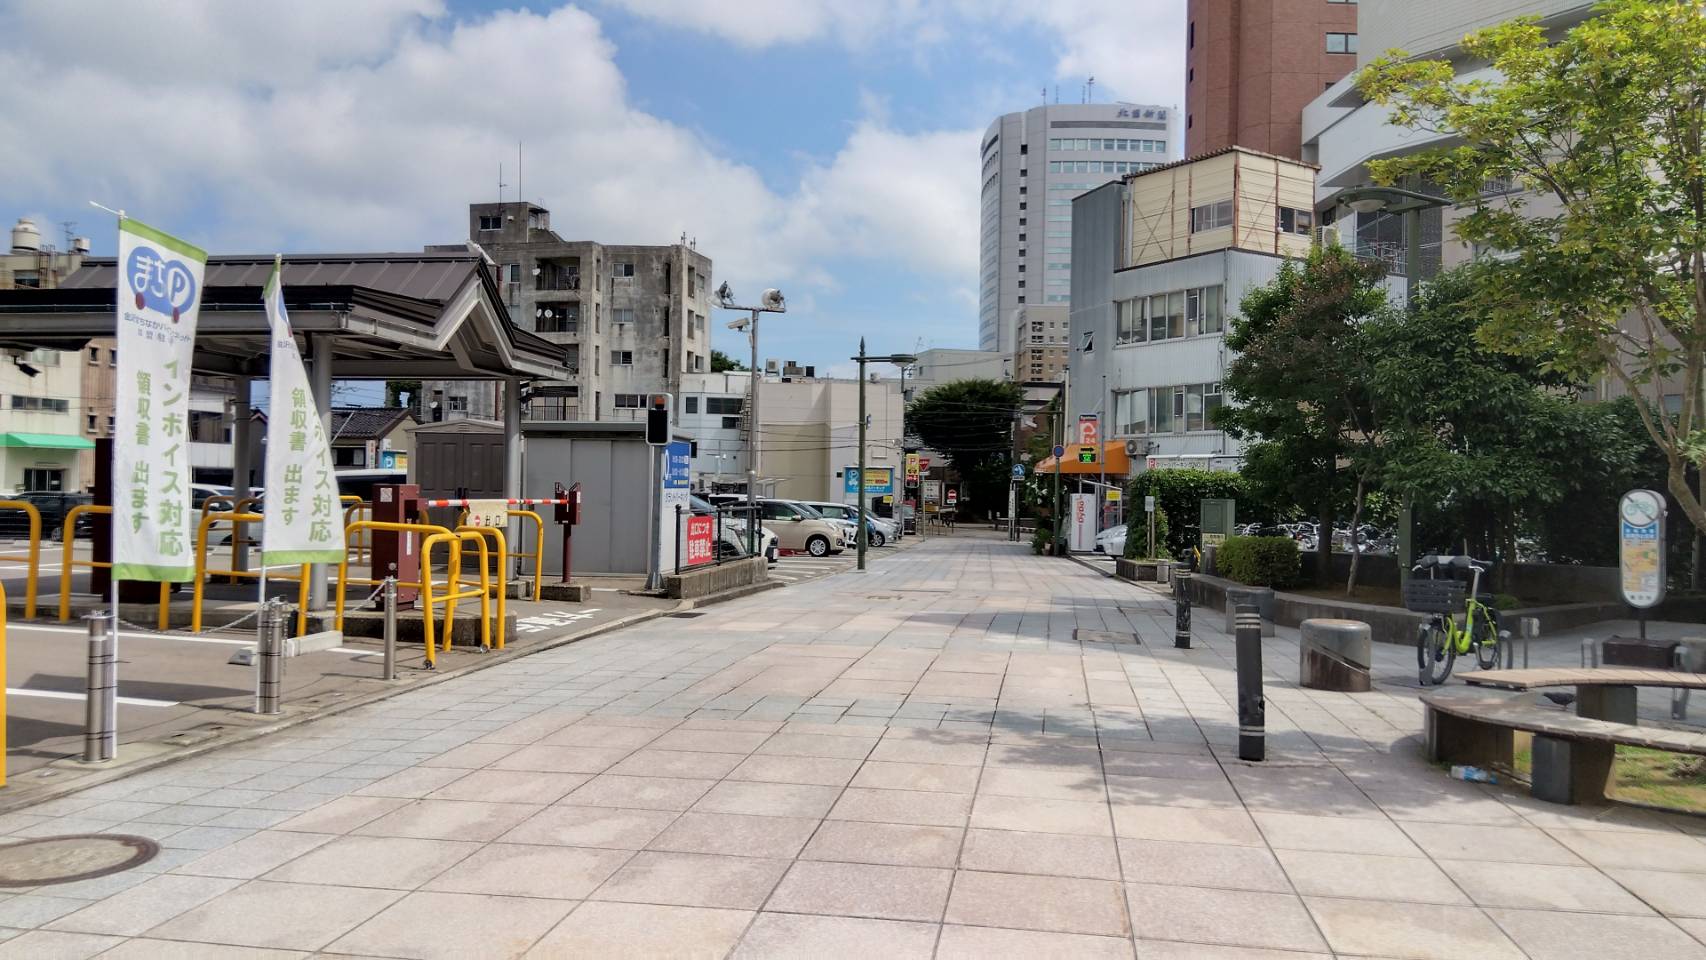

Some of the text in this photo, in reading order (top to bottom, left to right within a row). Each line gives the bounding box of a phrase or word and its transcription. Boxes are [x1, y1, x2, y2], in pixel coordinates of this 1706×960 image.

[158, 360, 184, 557] インボイス対応
[1149, 459, 1155, 468] P
[485, 515, 501, 527] 出口
[690, 522, 710, 536] 出口につき
[689, 537, 711, 560] 駐車禁止
